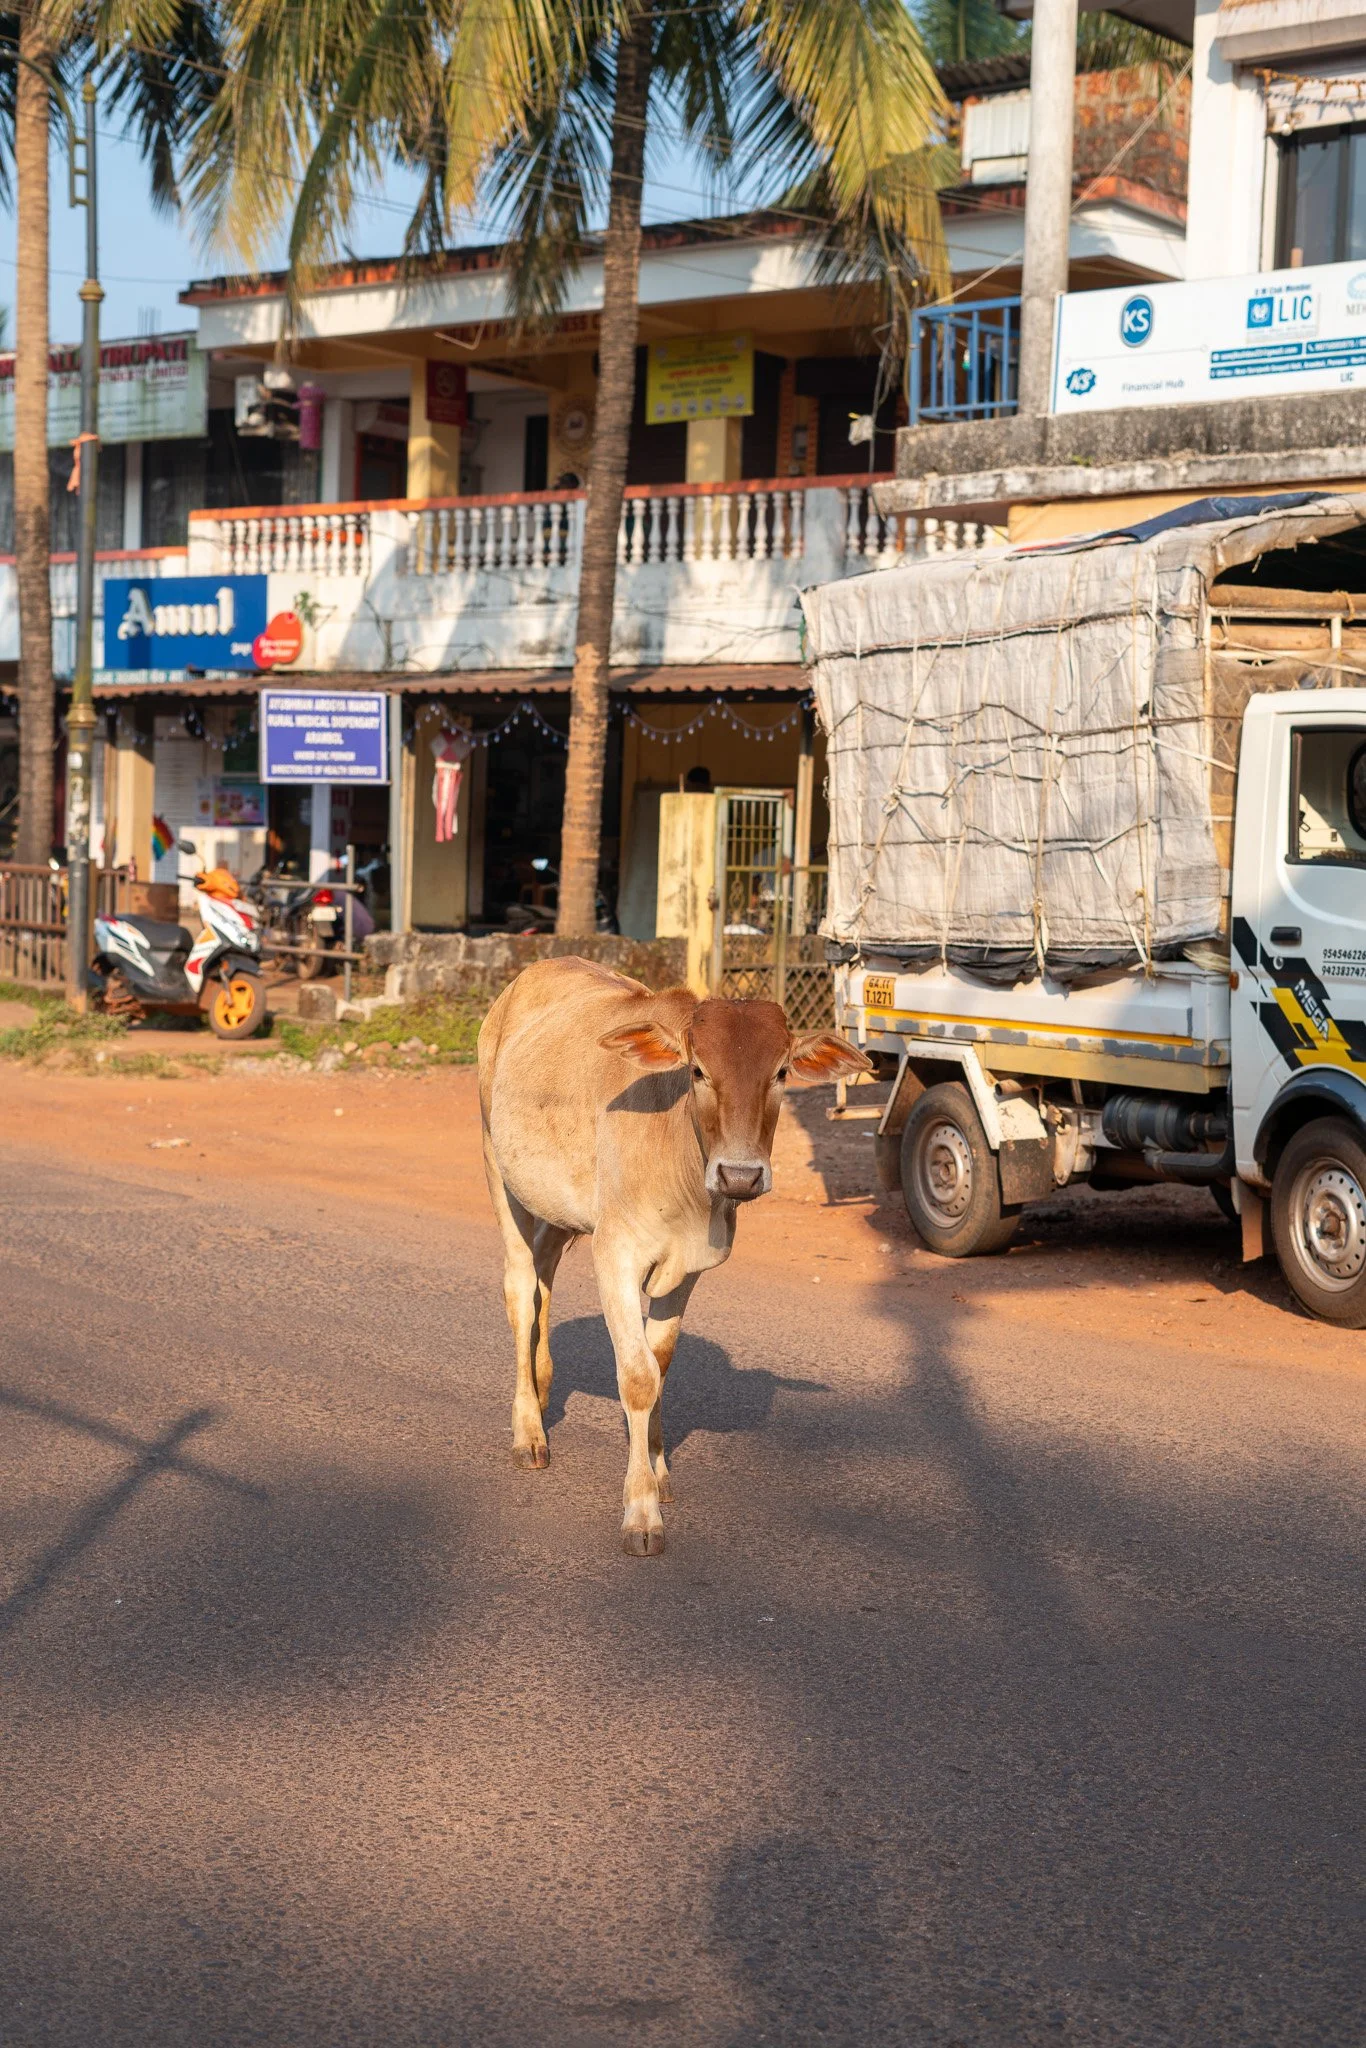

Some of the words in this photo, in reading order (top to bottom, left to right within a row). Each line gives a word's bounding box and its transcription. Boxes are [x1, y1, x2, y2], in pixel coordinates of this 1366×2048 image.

[1279, 295, 1313, 322] LIC
[1123, 307, 1150, 333] KS
[1069, 371, 1093, 392] KS
[1122, 382, 1162, 393] Financial
[1165, 379, 1184, 389] Hub
[118, 587, 234, 640] Amul
[267, 714, 294, 727] RURAL
[295, 714, 330, 728] MEDICAL
[331, 715, 380, 729] DISPENSARY
[1322, 965, 1366, 977] 942383747
[866, 990, 892, 1005] T.1271
[1294, 979, 1329, 1043] MEGA
